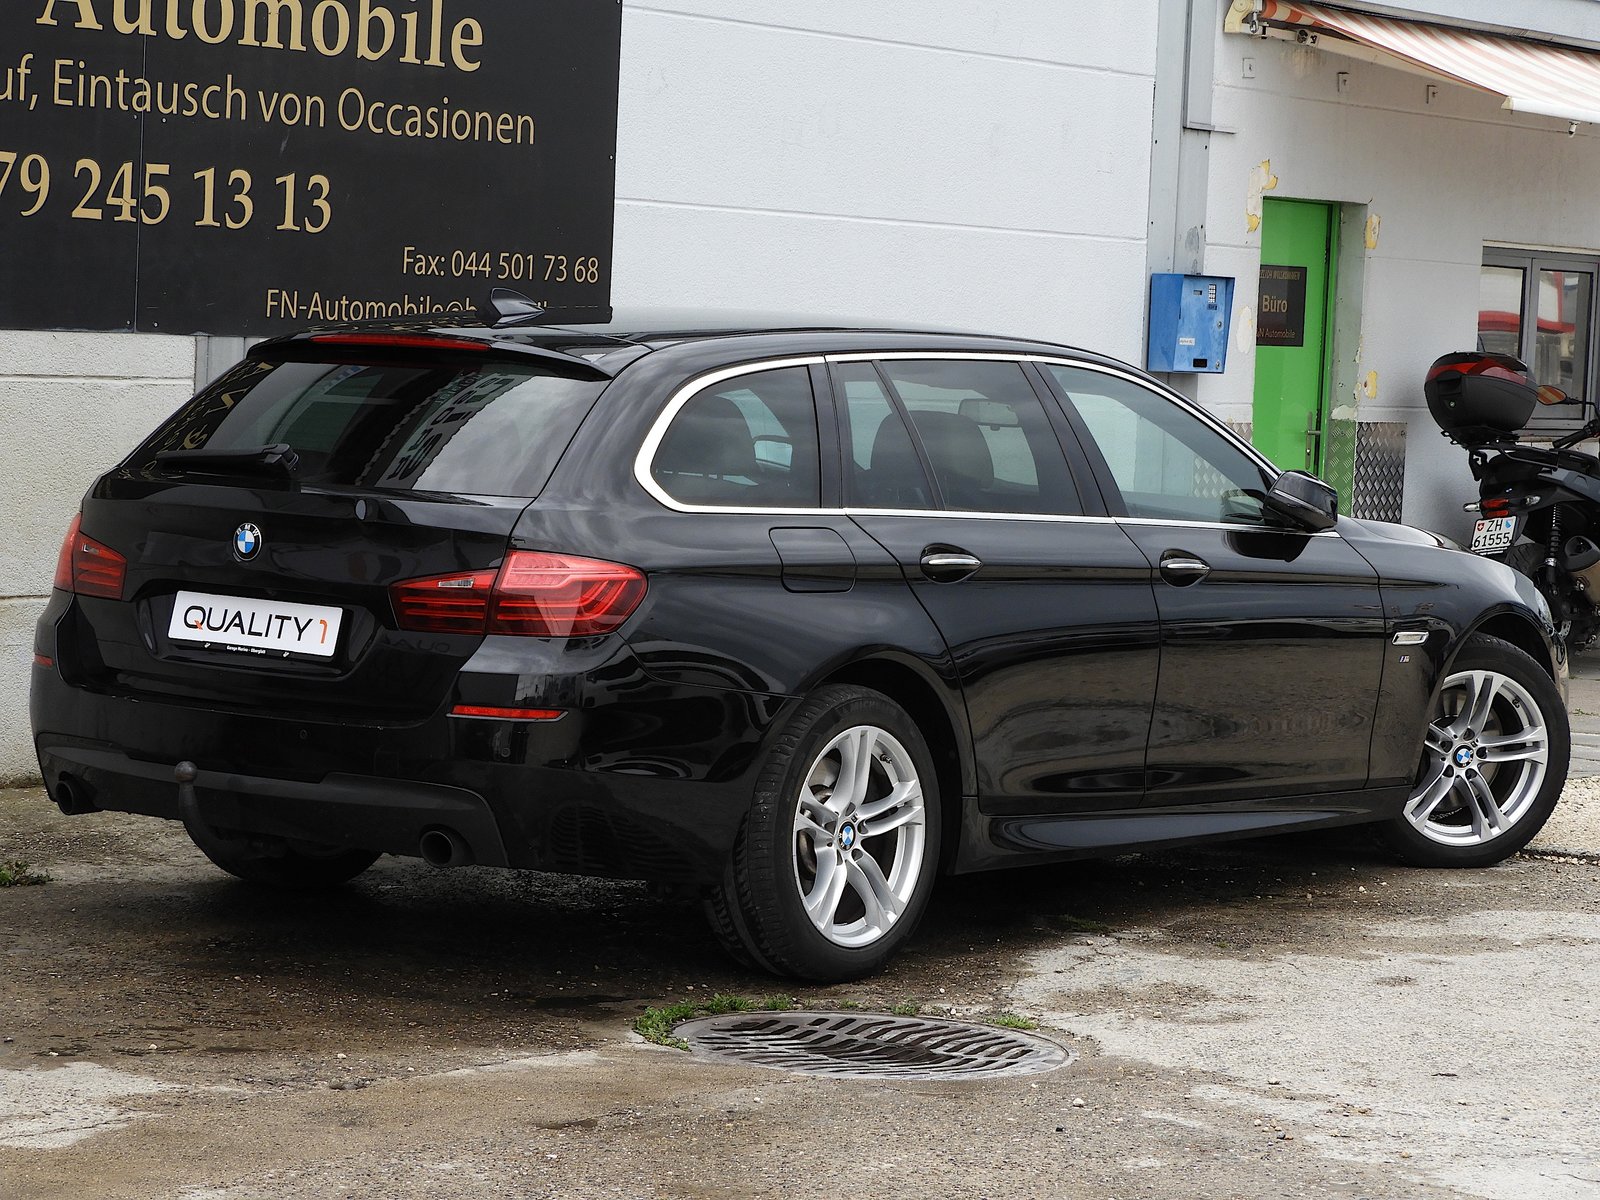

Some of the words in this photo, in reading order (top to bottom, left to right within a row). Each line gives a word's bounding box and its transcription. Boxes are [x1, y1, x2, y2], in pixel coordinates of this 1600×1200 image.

[52, 59, 247, 120] Eintausch
[258, 91, 326, 127] von
[337, 87, 536, 145] Occasionen
[71, 158, 171, 225] 245
[193, 167, 254, 230] 13
[275, 174, 332, 233] 13
[402, 246, 446, 277] Fax:
[450, 250, 492, 278] 044
[498, 252, 535, 281] 501
[543, 254, 568, 283] 73
[573, 256, 599, 284] 68
[1262, 294, 1288, 313] Büro
[1473, 532, 1510, 547] 61555
[1486, 519, 1503, 532] ZH
[183, 604, 313, 642] QUALITY
